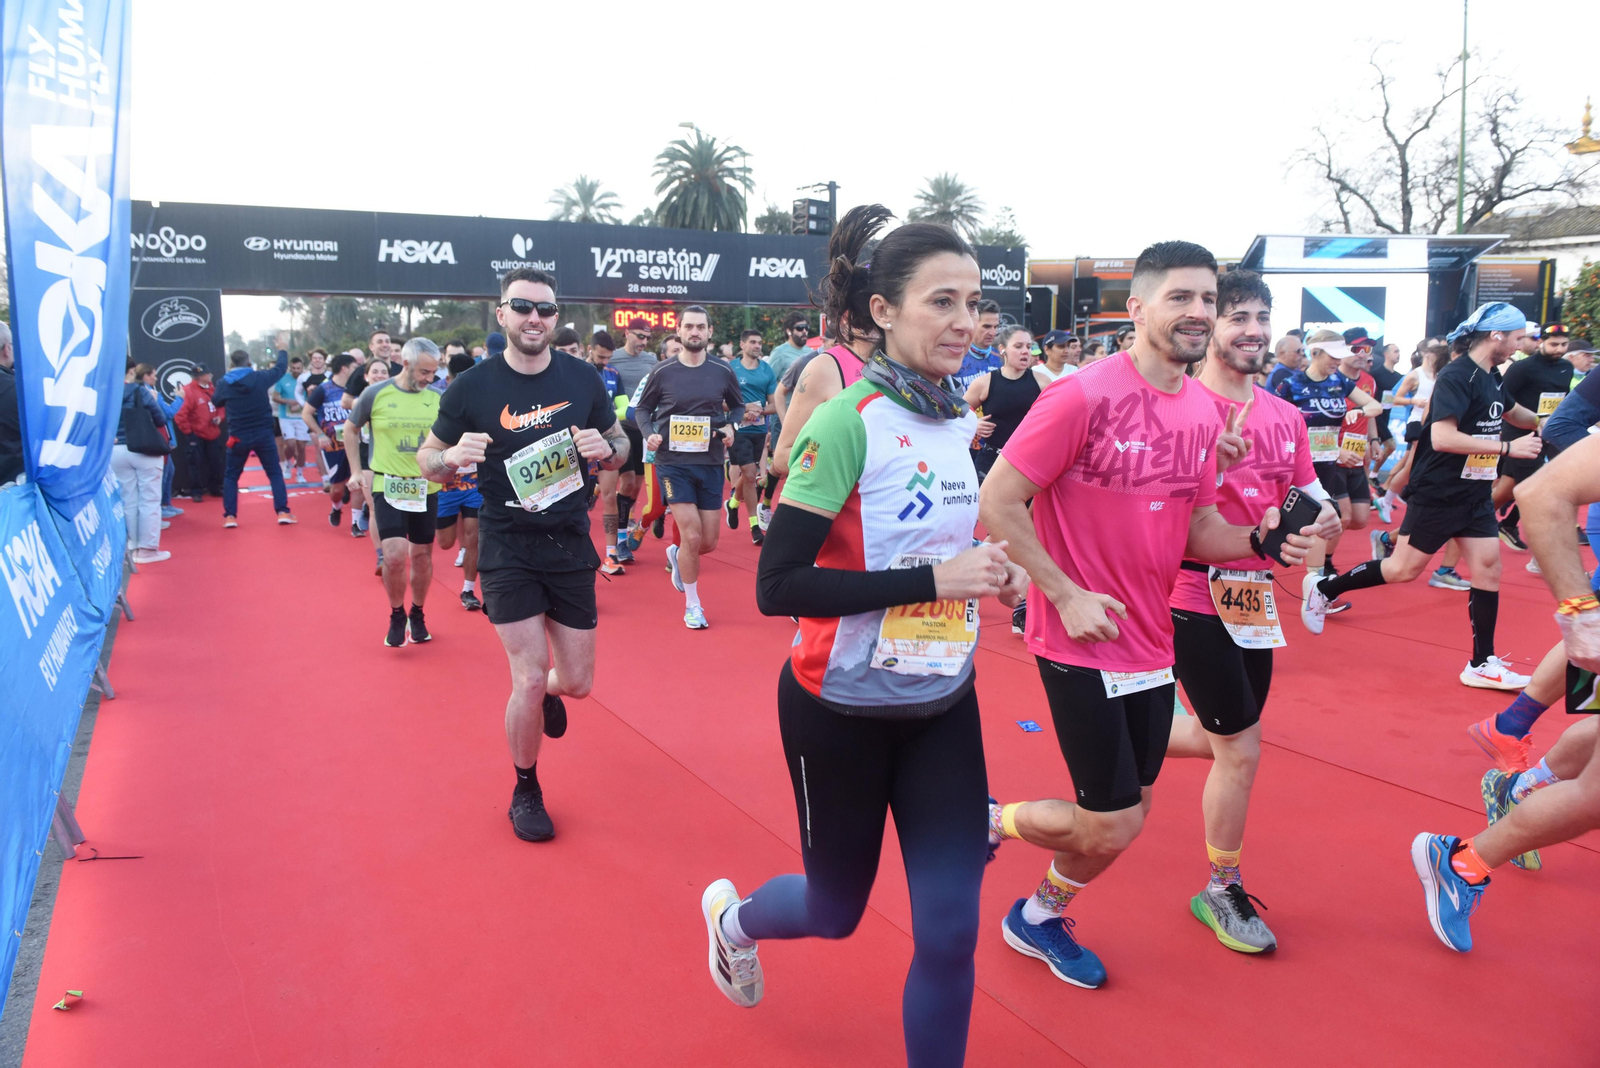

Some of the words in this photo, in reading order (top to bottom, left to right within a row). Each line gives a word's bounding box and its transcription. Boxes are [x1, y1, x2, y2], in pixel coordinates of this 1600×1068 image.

[27, 23, 56, 101] FLY
[58, 0, 87, 110] HUM
[273, 239, 338, 252] HYUNDAI
[378, 239, 456, 265] HOKA
[616, 247, 701, 266] maratón
[639, 262, 702, 281] sevilla
[749, 257, 807, 278] HOKA
[31, 124, 112, 469] HOKA
[628, 284, 639, 293] 28
[640, 286, 665, 294] enero
[667, 285, 688, 294] 2024
[673, 425, 704, 436] 12357
[519, 451, 564, 484] 9212
[390, 482, 417, 494] 8663
[941, 480, 966, 491] Naeva
[943, 492, 972, 506] running
[0, 520, 62, 640] HOKA
[1220, 587, 1261, 612] 4435
